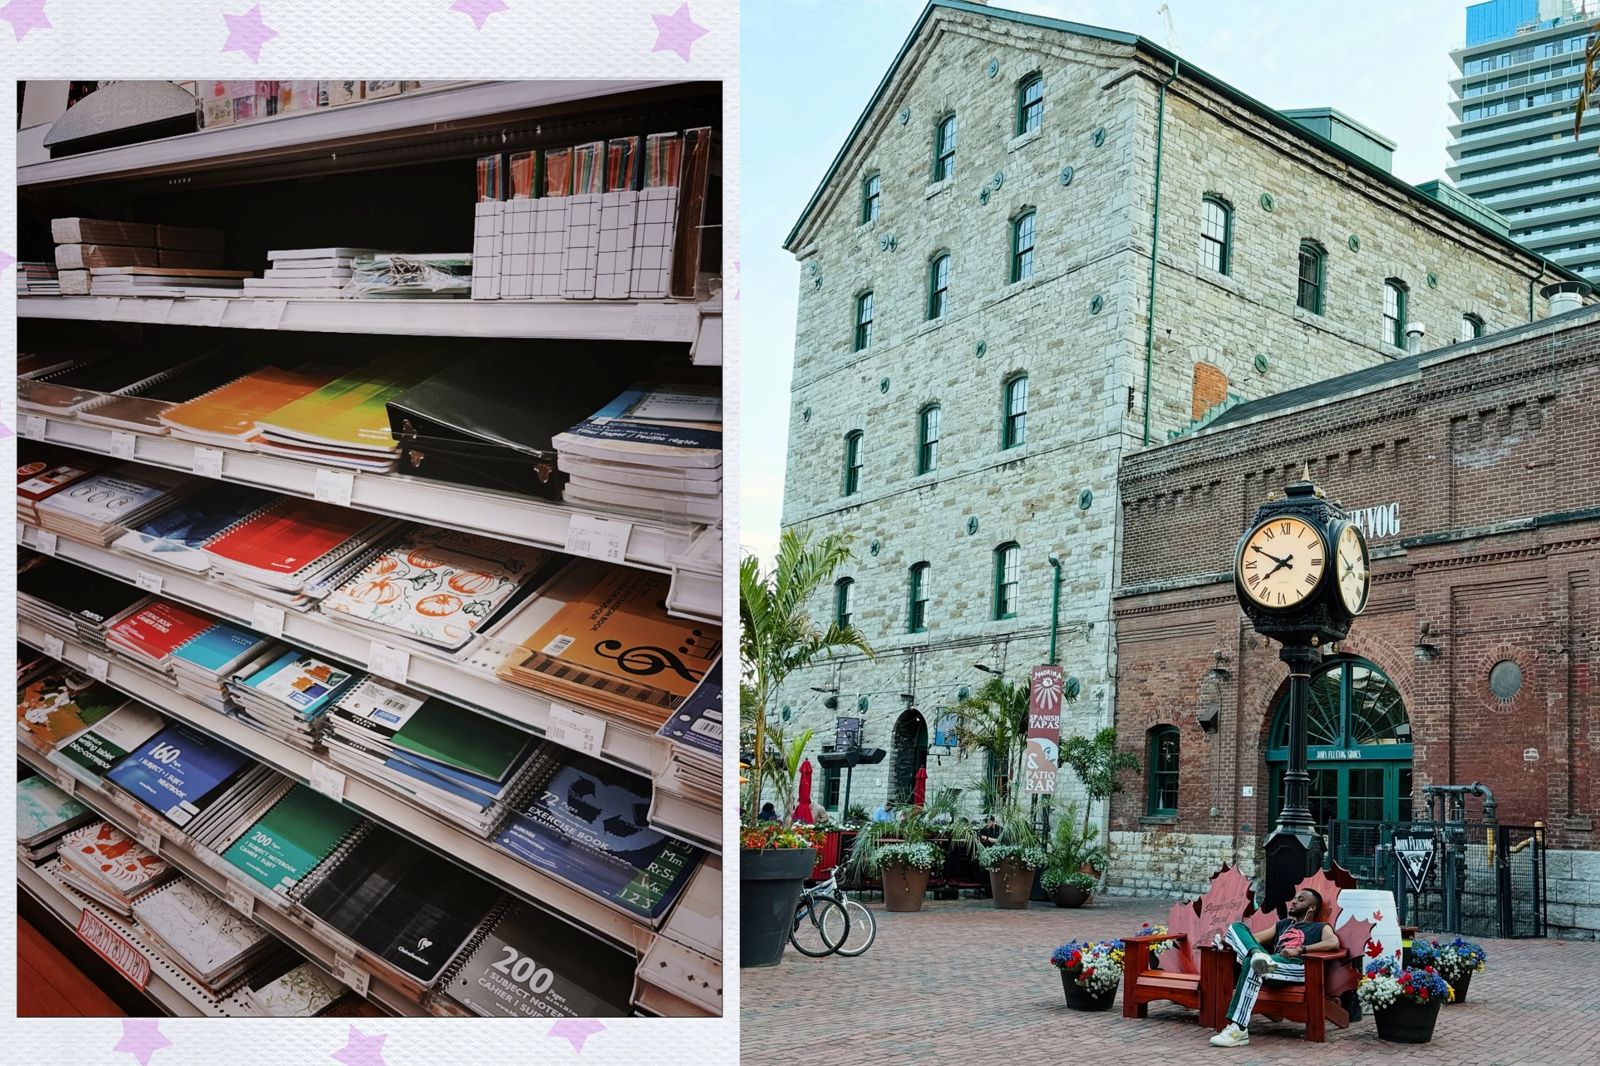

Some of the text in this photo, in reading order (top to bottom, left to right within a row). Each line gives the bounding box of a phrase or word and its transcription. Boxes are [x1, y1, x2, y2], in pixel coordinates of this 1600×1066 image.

[600, 431, 627, 440] Paper
[80, 609, 103, 622] memo
[1029, 714, 1060, 722] SPANISH
[1029, 721, 1060, 730] TAPAS
[79, 737, 116, 761] writing tablet
[148, 741, 181, 764] 160
[1027, 752, 1039, 769] &
[1026, 770, 1056, 780] PATIO
[1025, 779, 1055, 792] BAR
[528, 806, 577, 834] EXERCISE
[576, 829, 610, 850] BOOK
[251, 831, 273, 846] 200
[267, 854, 297, 873] NOTEBOOK
[491, 945, 567, 1004] 200 Pages
[478, 977, 512, 1004] CAHIER
[489, 971, 531, 998] SUBJECT
